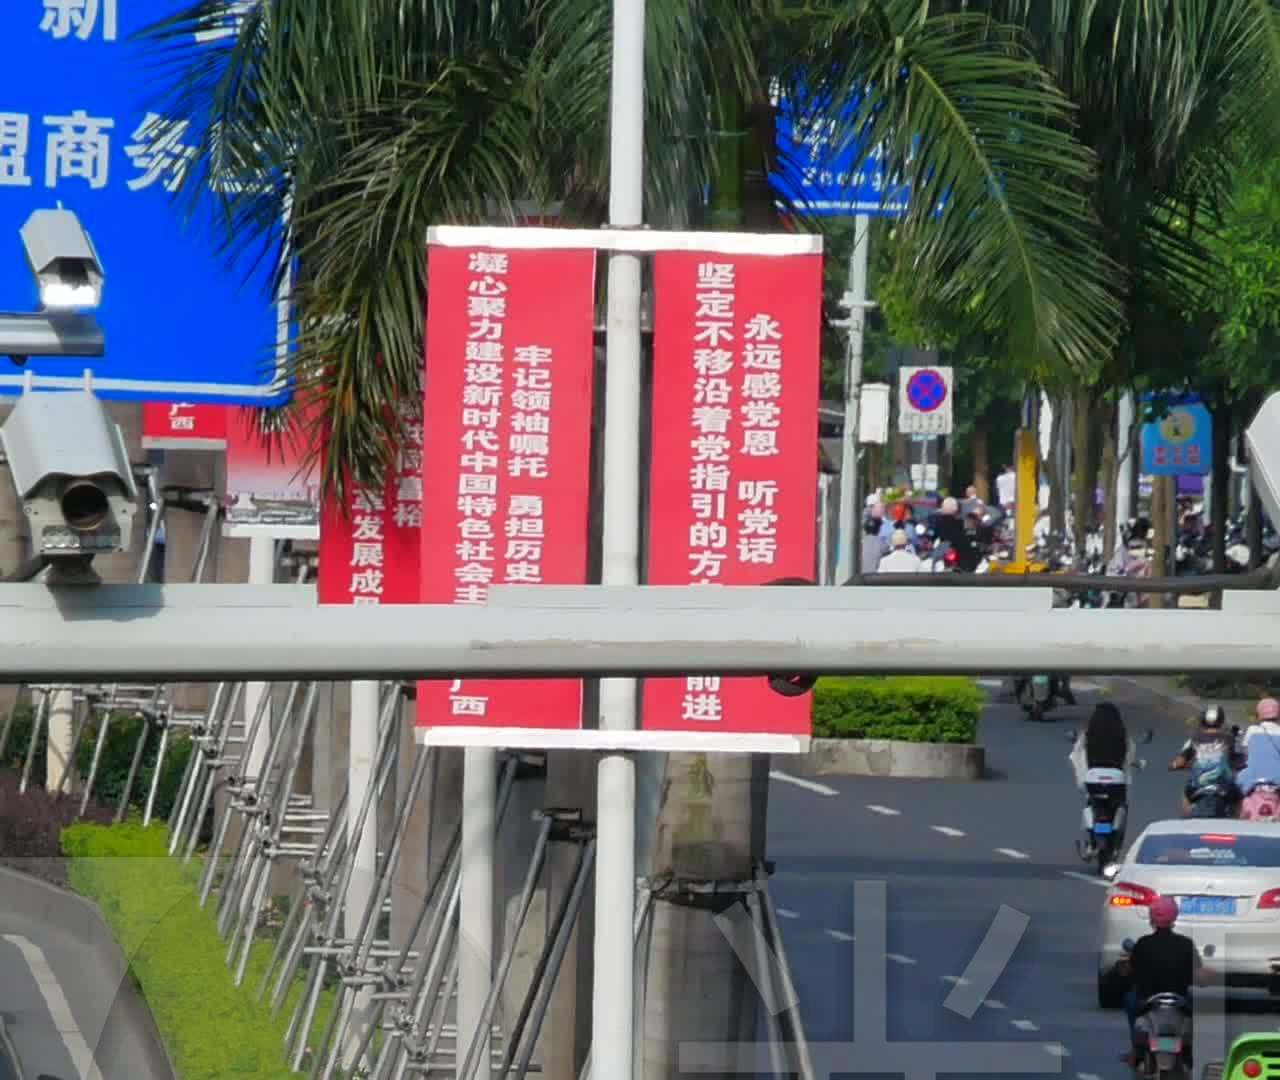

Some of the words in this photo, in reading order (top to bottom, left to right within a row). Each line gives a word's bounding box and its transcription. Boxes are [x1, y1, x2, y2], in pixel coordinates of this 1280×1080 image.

[507, 345, 552, 478] 牢记领袖嘱托
[740, 313, 782, 456] 永远感党恩
[504, 495, 545, 585] 勇担历史
[736, 480, 779, 564] 听党话
